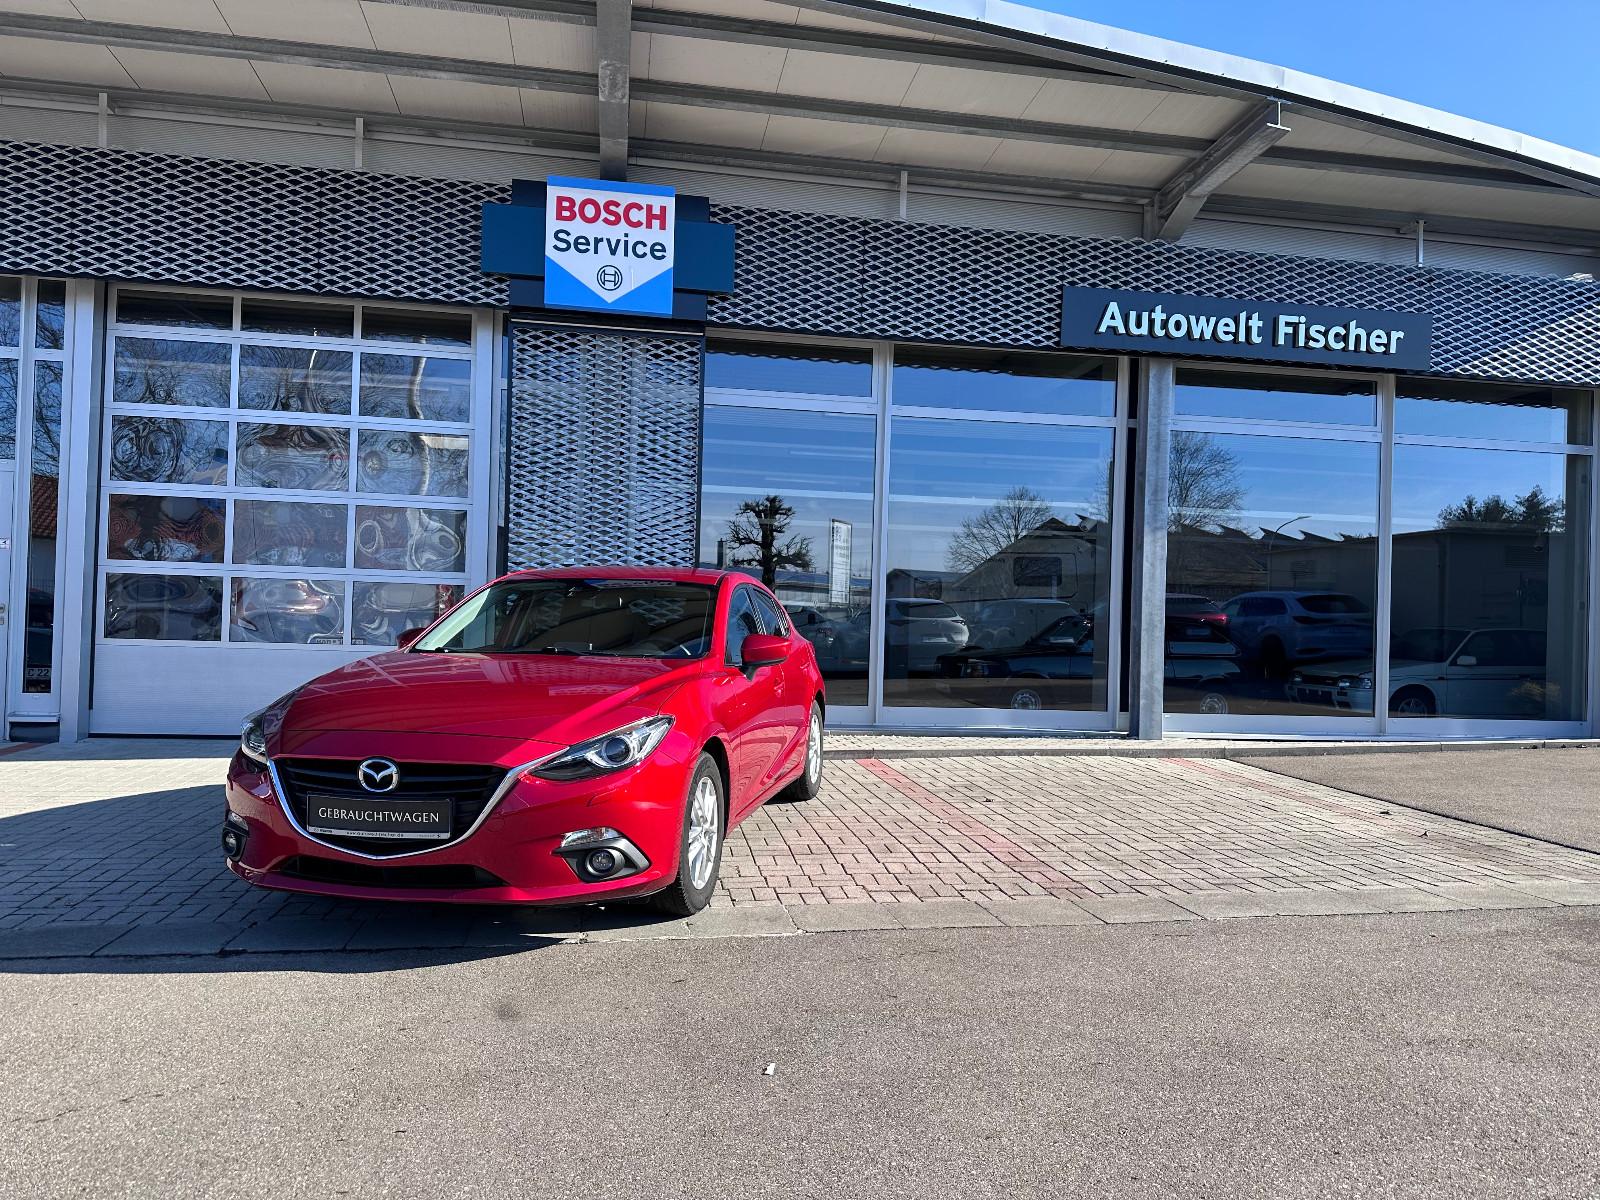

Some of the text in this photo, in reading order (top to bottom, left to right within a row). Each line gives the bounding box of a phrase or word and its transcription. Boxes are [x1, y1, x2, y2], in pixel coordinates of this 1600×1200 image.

[555, 195, 667, 231] BOSCH
[552, 228, 667, 260] Service
[1098, 301, 1404, 354] Autowelt Fischer
[318, 807, 439, 823] GEBRAUCHTWAGEN
